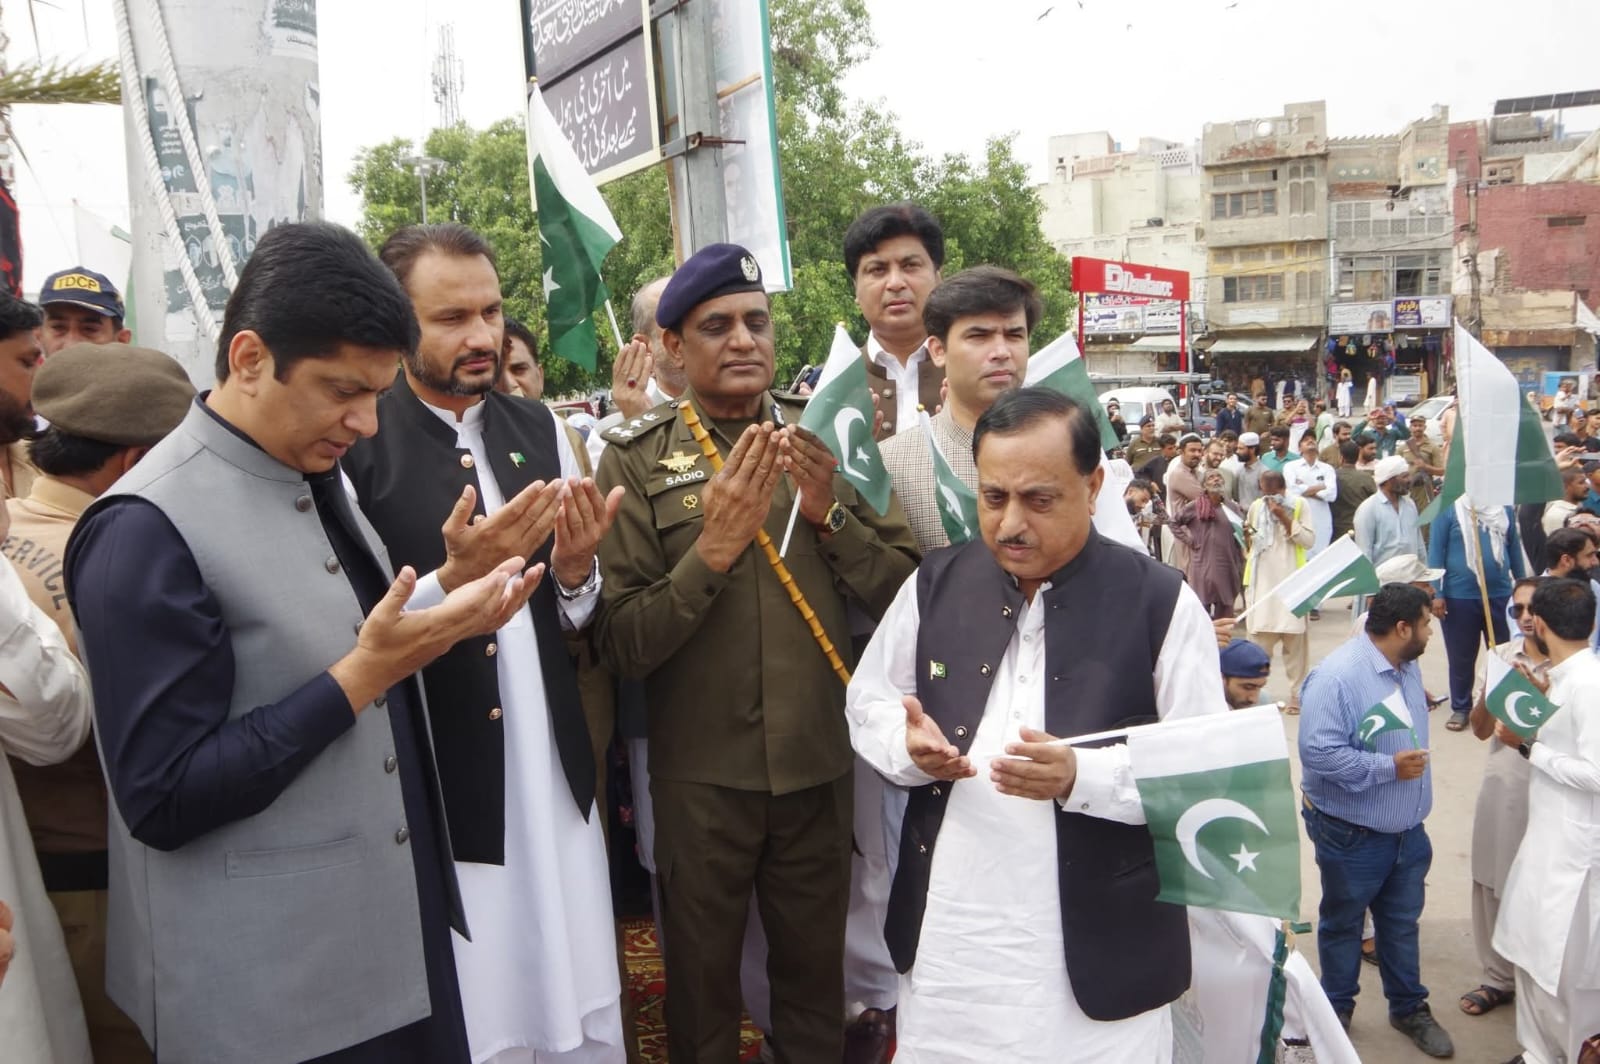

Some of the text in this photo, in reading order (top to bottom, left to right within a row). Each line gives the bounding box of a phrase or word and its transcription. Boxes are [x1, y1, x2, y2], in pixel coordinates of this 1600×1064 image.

[574, 75, 588, 124] نبی
[588, 61, 612, 115] آخری
[613, 56, 633, 101] میں
[589, 114, 608, 167] کوئی
[605, 120, 619, 155] بعد
[618, 106, 637, 150] میرے
[57, 276, 97, 289] TDCP
